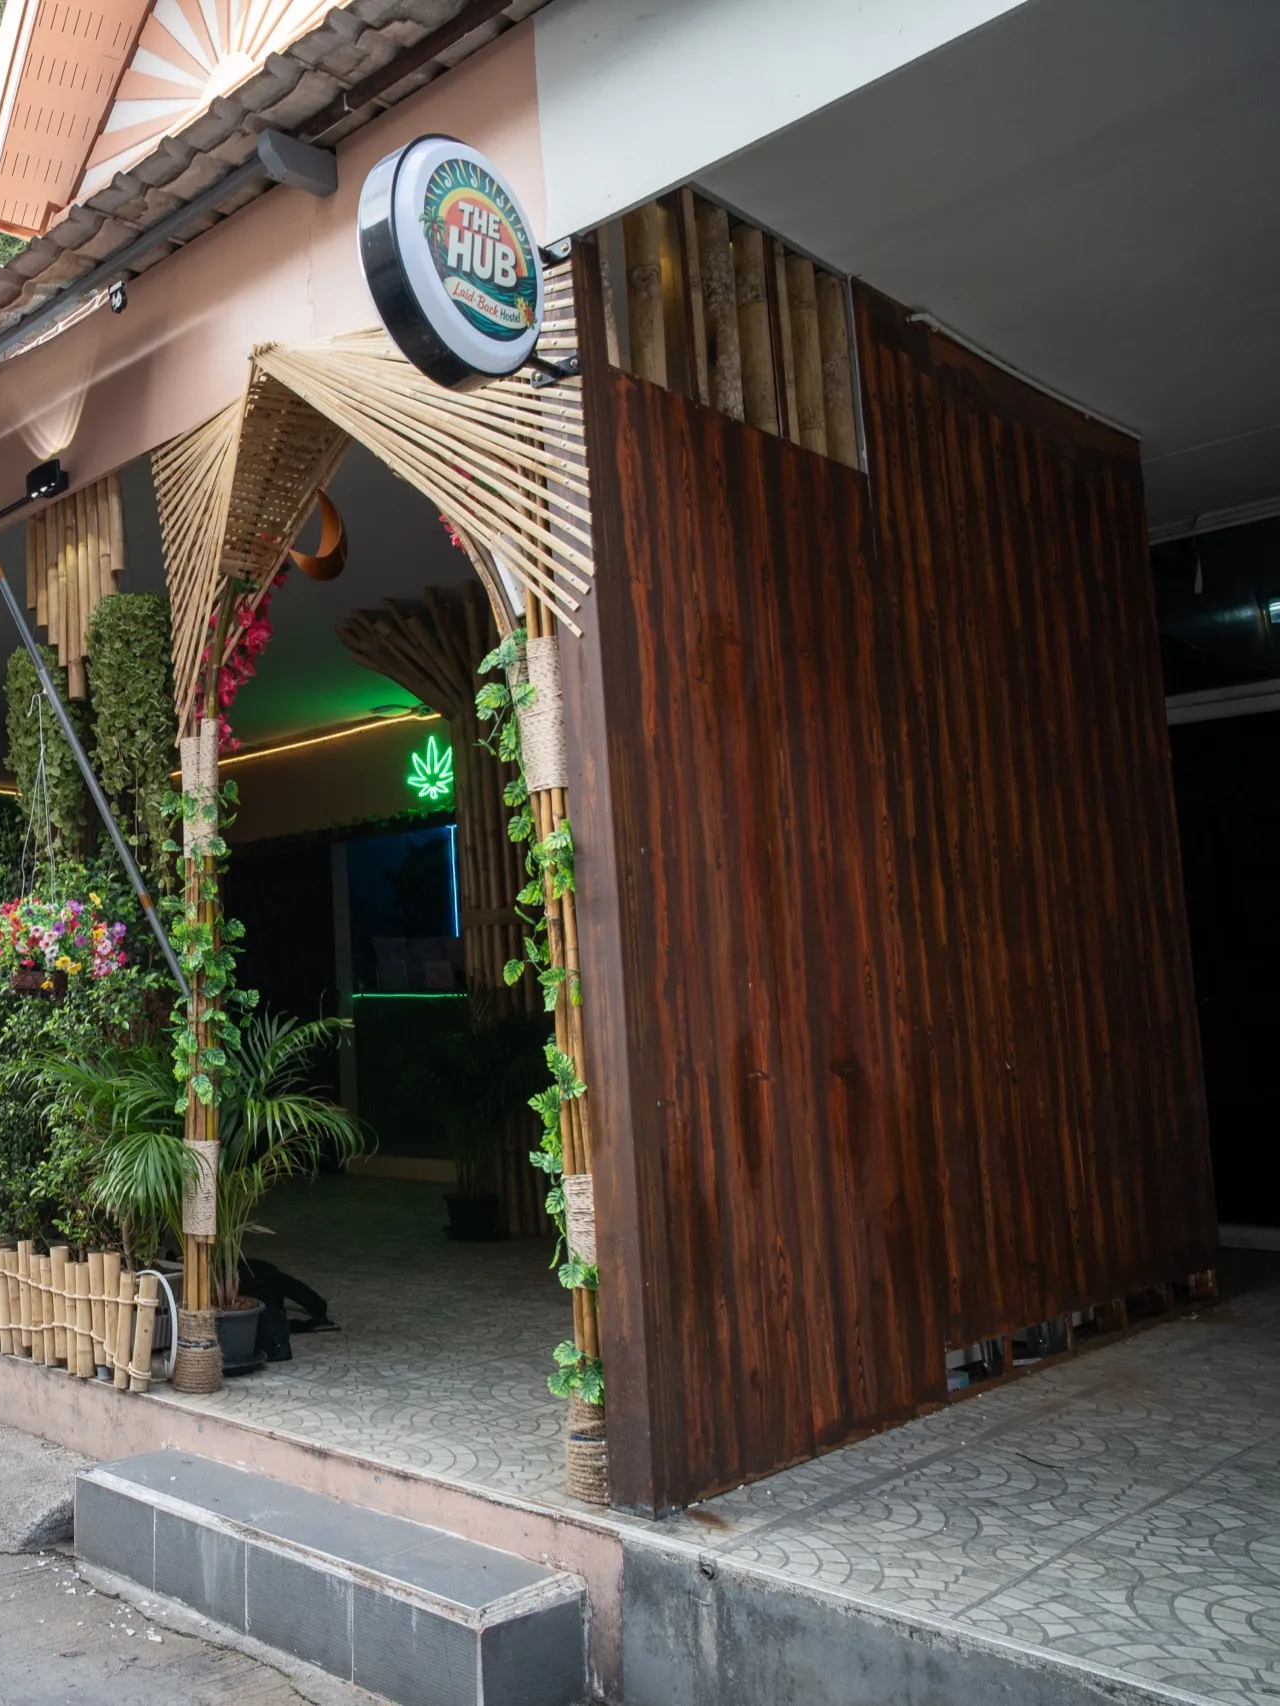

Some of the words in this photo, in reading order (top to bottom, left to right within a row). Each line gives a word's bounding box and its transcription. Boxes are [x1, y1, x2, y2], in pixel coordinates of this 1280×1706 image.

[458, 200, 502, 240] THE
[447, 224, 517, 288] HUB
[500, 308, 522, 324] Hostel
